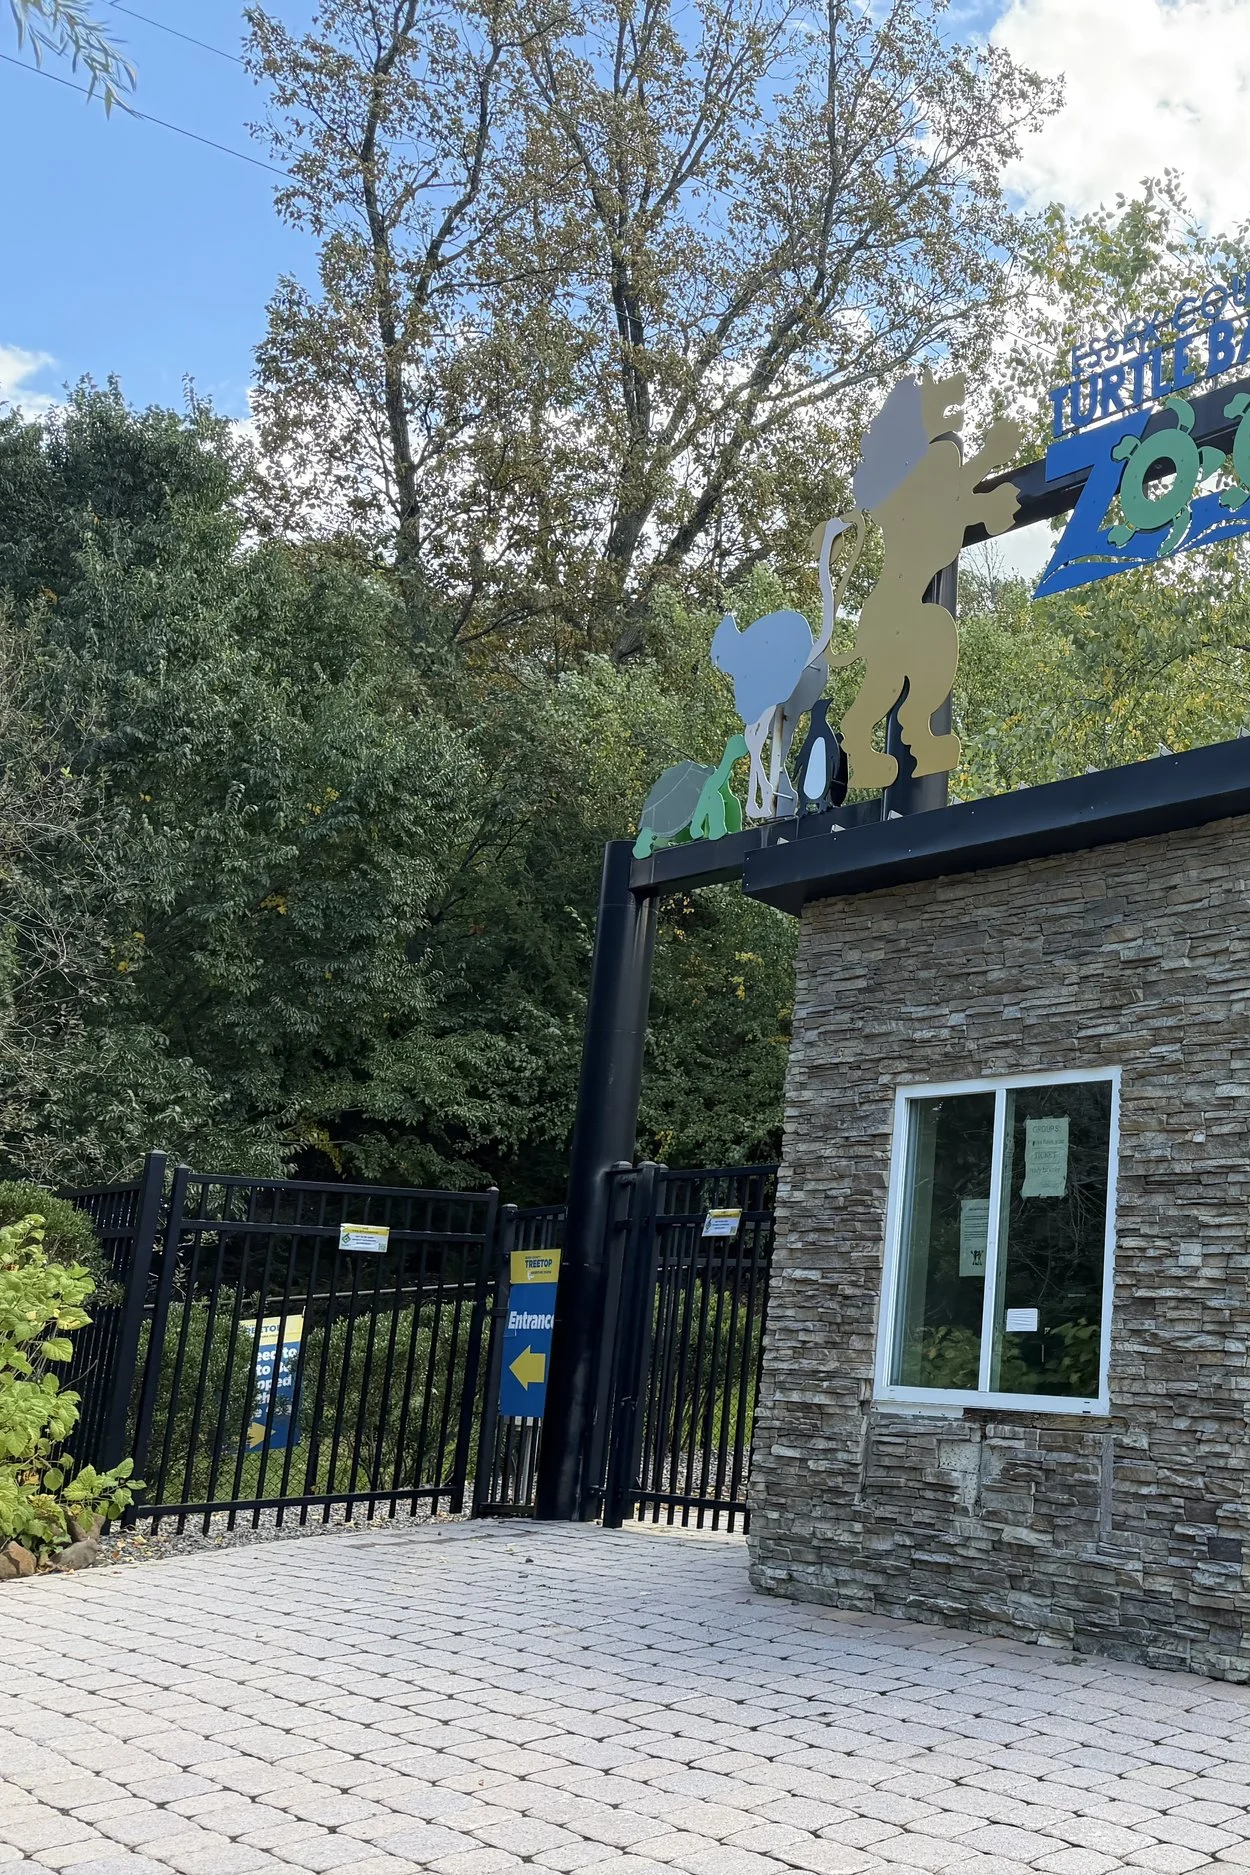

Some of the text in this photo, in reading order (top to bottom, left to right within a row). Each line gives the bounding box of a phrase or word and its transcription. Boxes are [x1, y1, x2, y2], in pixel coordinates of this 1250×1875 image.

[1071, 310, 1161, 376] ESSEX
[1049, 334, 1196, 438] TURTLE
[525, 1258, 553, 1269] TREETOP
